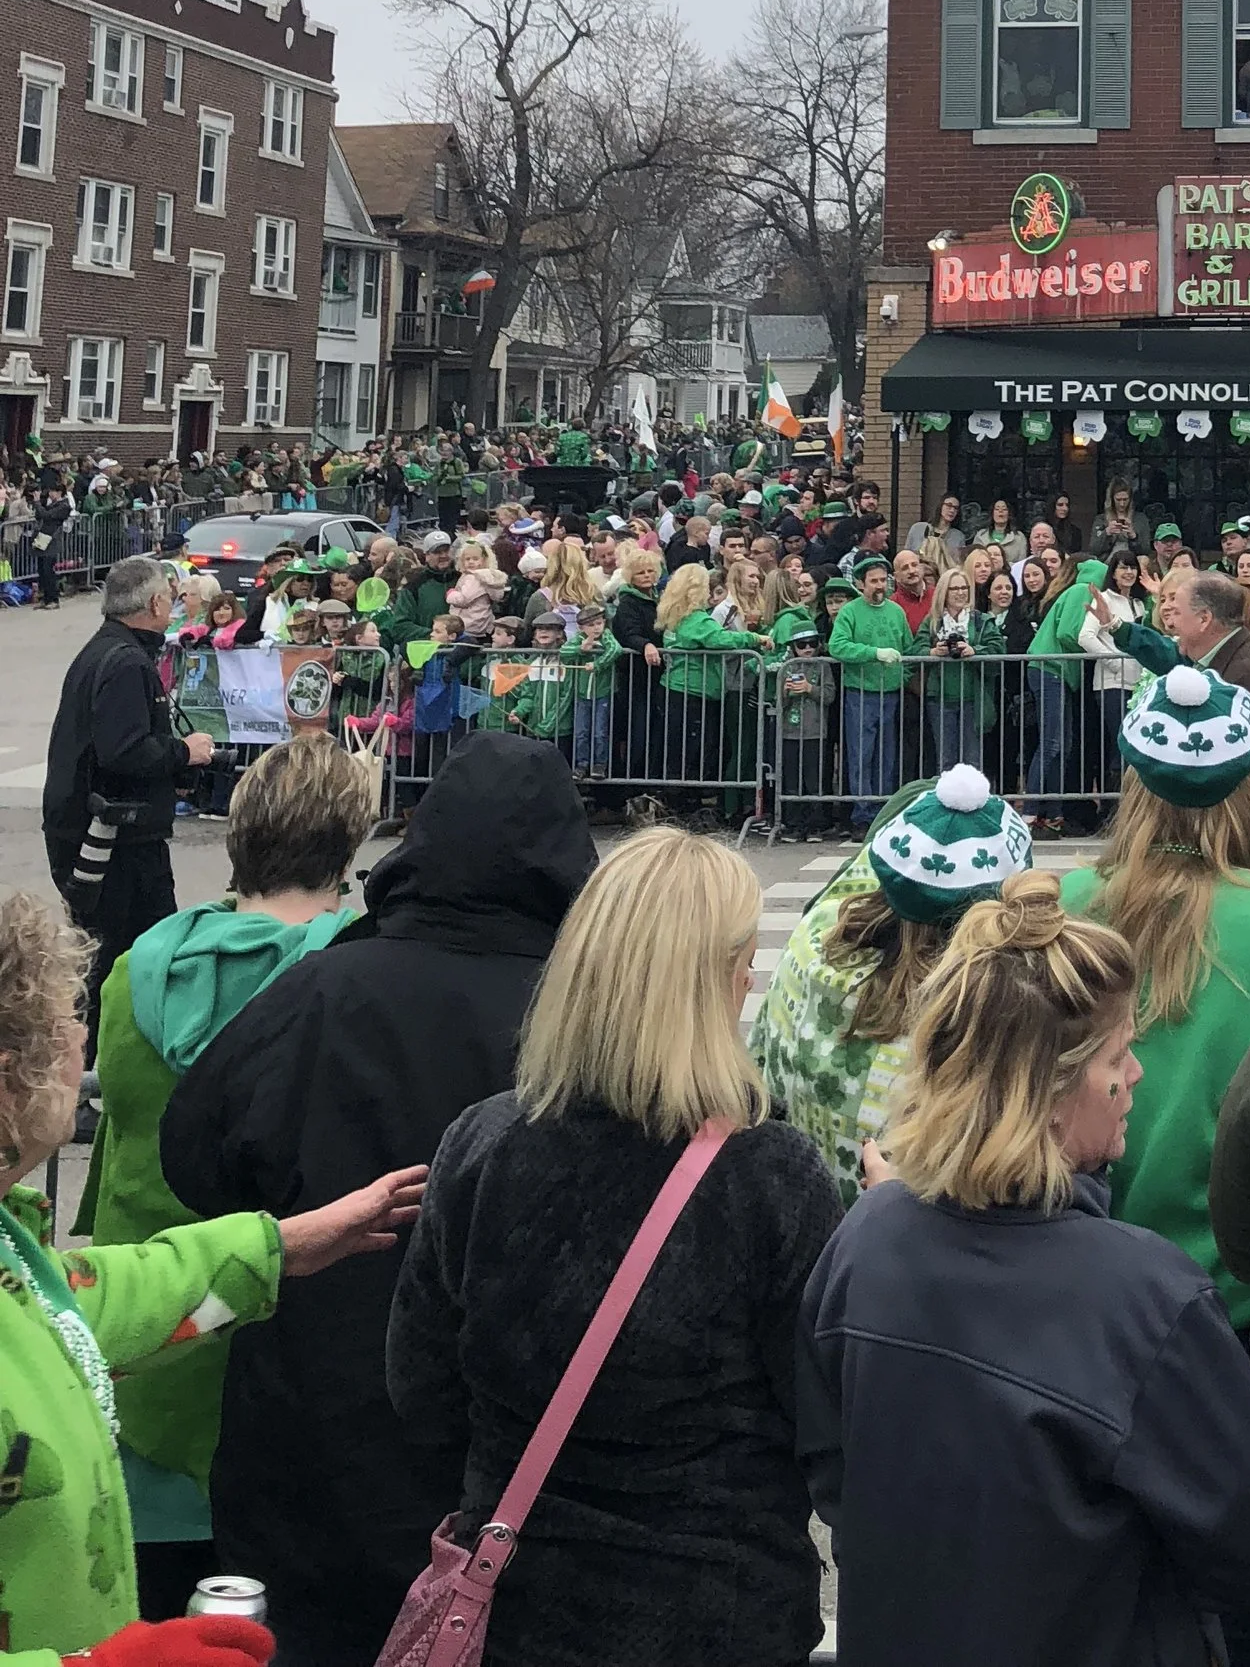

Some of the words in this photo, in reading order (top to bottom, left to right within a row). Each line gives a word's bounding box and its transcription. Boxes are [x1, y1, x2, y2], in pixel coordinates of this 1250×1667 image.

[938, 248, 1151, 304] Budweiser
[1204, 255, 1234, 275] &
[994, 380, 1054, 403] THE
[1061, 380, 1118, 403] PAT
